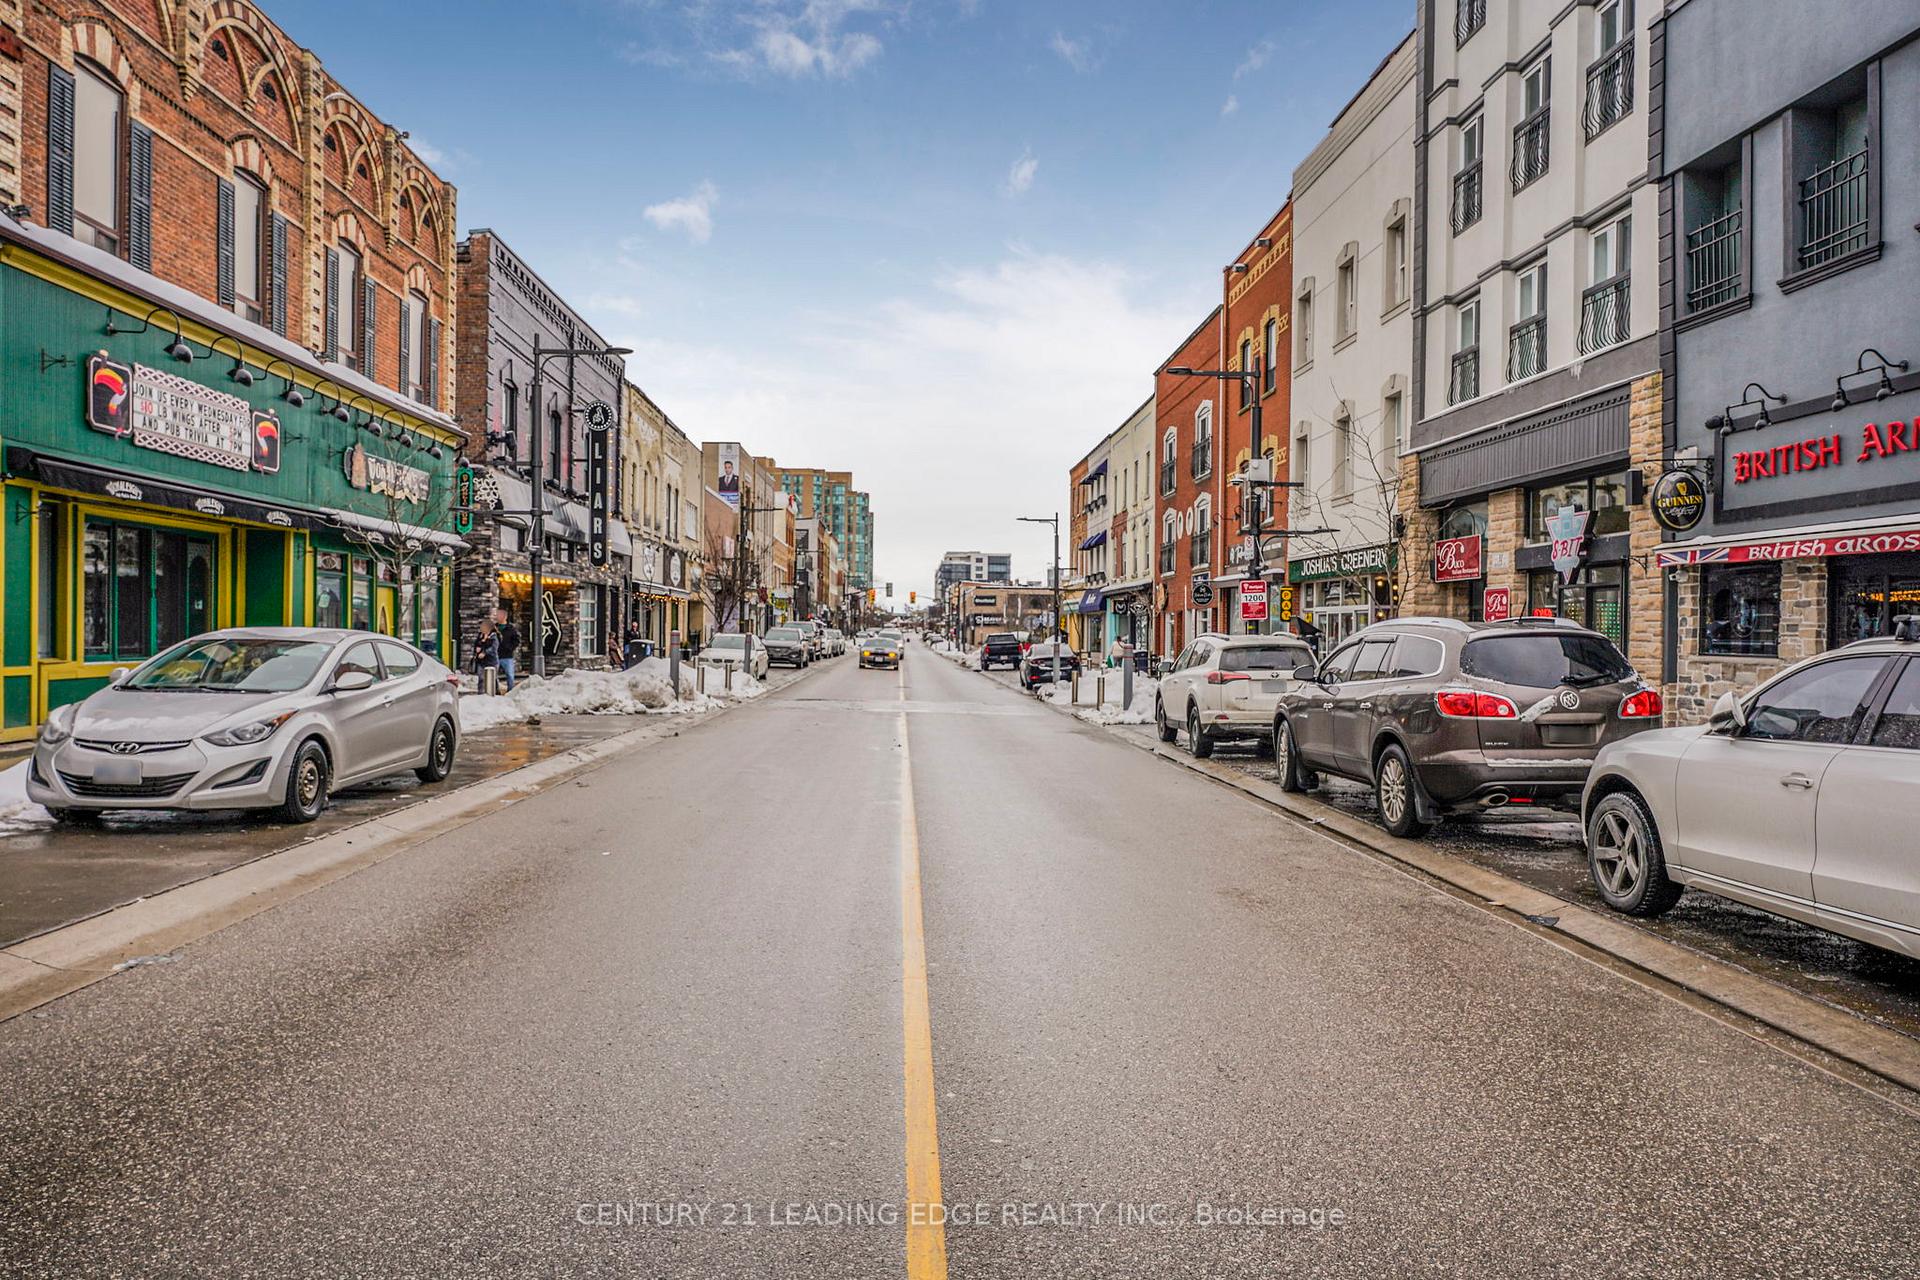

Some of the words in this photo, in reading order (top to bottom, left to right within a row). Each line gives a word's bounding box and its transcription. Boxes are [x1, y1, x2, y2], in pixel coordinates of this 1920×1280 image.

[134, 382, 153, 399] JOIN
[158, 390, 167, 403] US
[171, 395, 194, 410] EVERY
[198, 403, 237, 424] WEDNESDAY
[143, 416, 158, 431] AND
[165, 422, 181, 437] PUB
[185, 427, 209, 444] TRIVIA
[216, 437, 225, 448] AT
[158, 407, 168, 419] LB
[173, 410, 195, 427] WINGS
[200, 419, 220, 433] AFTER
[1732, 433, 1841, 485] BRITISH
[592, 442, 603, 559] LIARS
[1657, 495, 1703, 508] GUINNESS
[1301, 555, 1338, 576] JOSHUA'S
[1341, 547, 1389, 572] GREENERY
[1244, 594, 1264, 602] 1200
